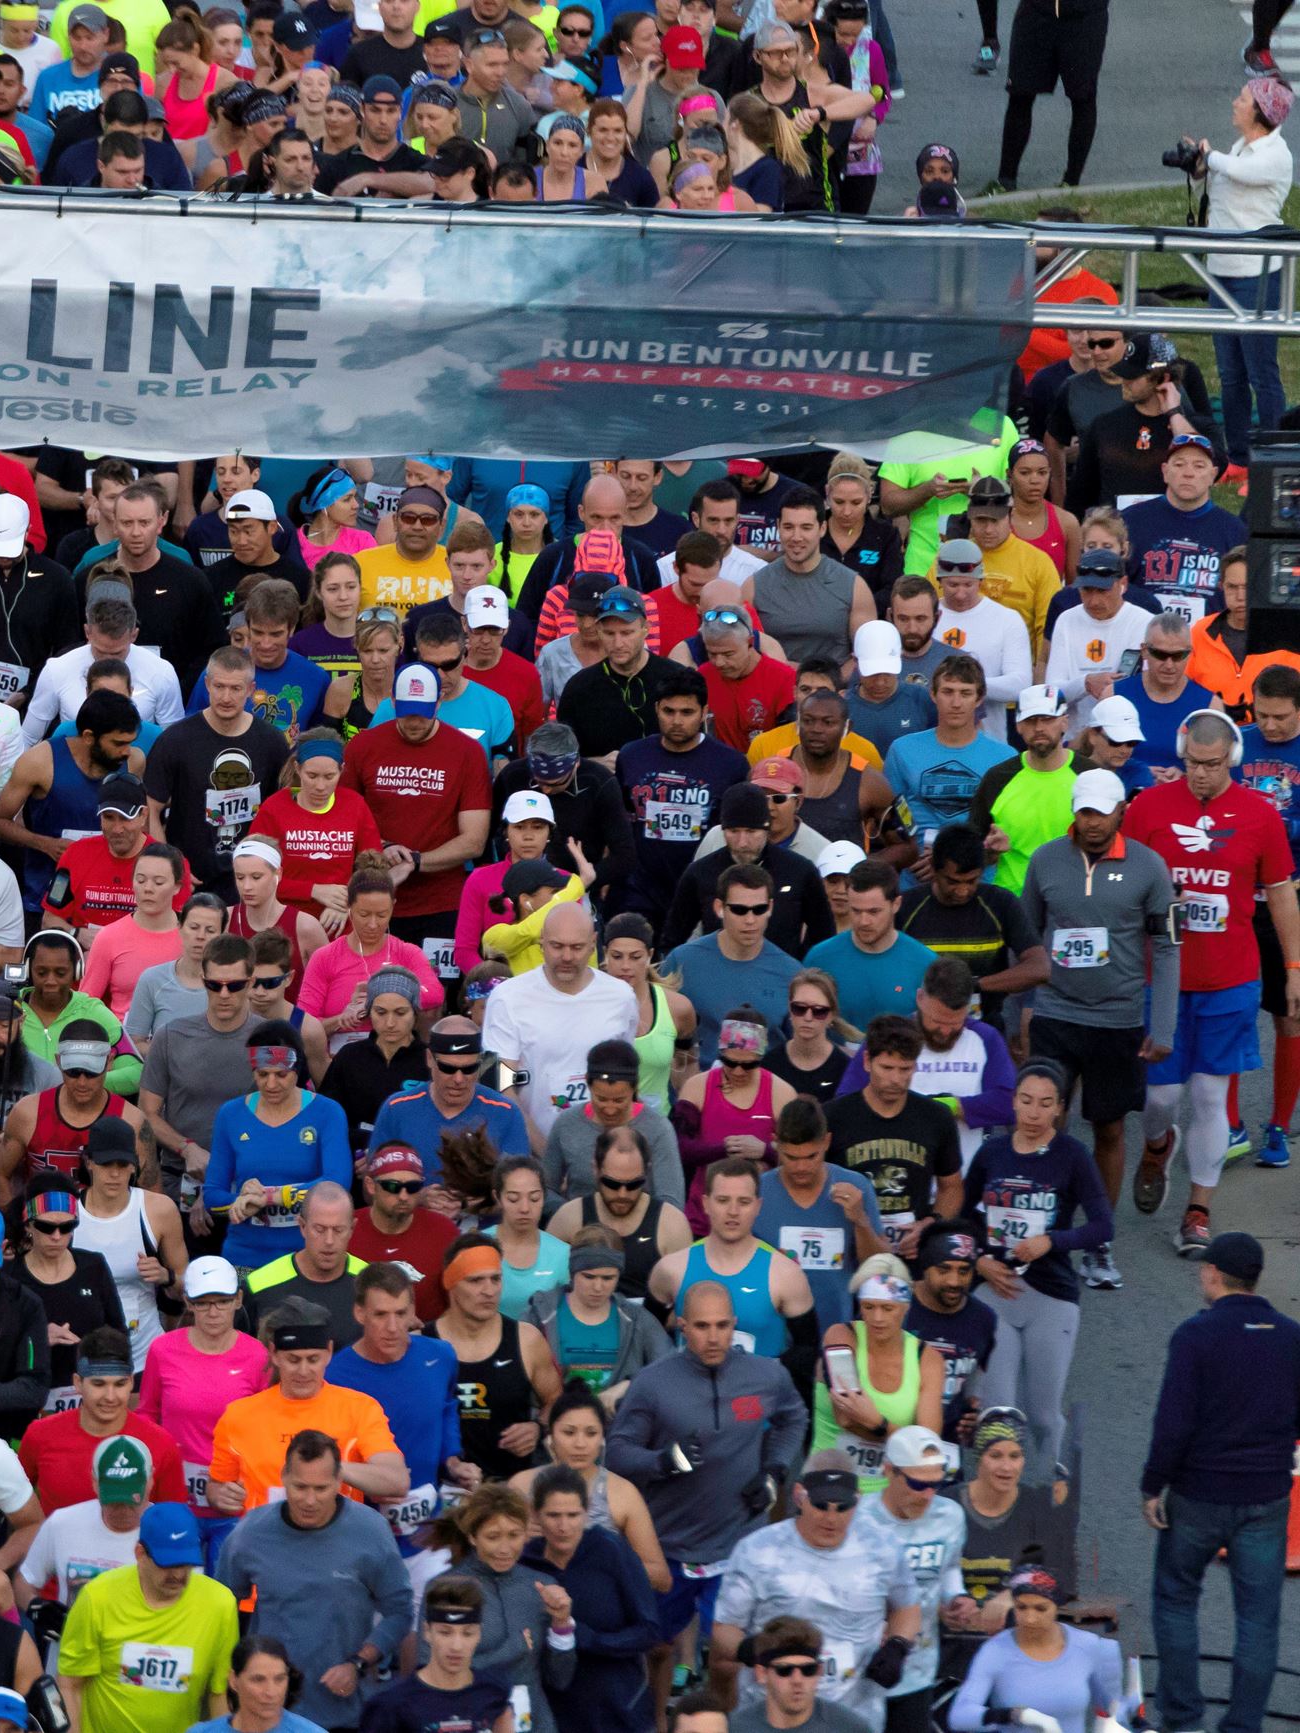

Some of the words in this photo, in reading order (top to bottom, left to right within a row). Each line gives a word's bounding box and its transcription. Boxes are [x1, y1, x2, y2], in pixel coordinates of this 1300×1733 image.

[26, 278, 322, 375] LINE
[541, 338, 629, 361] RUN
[638, 341, 933, 377] BENTONVILLE
[137, 371, 312, 398] RELAY
[552, 365, 661, 382] HALF
[680, 370, 905, 397] MARATHO
[652, 394, 718, 409] EST.
[732, 400, 810, 415] 2011
[1182, 554, 1197, 569] IS
[1199, 554, 1221, 572] NO
[1179, 567, 1219, 588] JOKE
[376, 576, 453, 603] RUN
[376, 765, 446, 783] MUSTACHE
[375, 777, 417, 788] RUNNING
[419, 779, 445, 792] CLUB
[669, 788, 684, 803] IS
[685, 786, 709, 805] NO
[217, 797, 250, 817] 1174
[655, 813, 692, 830] 1549
[285, 830, 355, 843] MUSTACHE
[285, 841, 327, 852] RUNNING
[1172, 867, 1231, 888] RWB
[1185, 902, 1218, 922] 1051
[1063, 940, 1094, 959] 295
[934, 1061, 979, 1073] LAURA
[1030, 1191, 1057, 1211] NO
[1001, 1220, 1029, 1240] 242
[802, 1240, 822, 1259] 75
[389, 1499, 431, 1527] 2458
[138, 1657, 178, 1680] 1617
